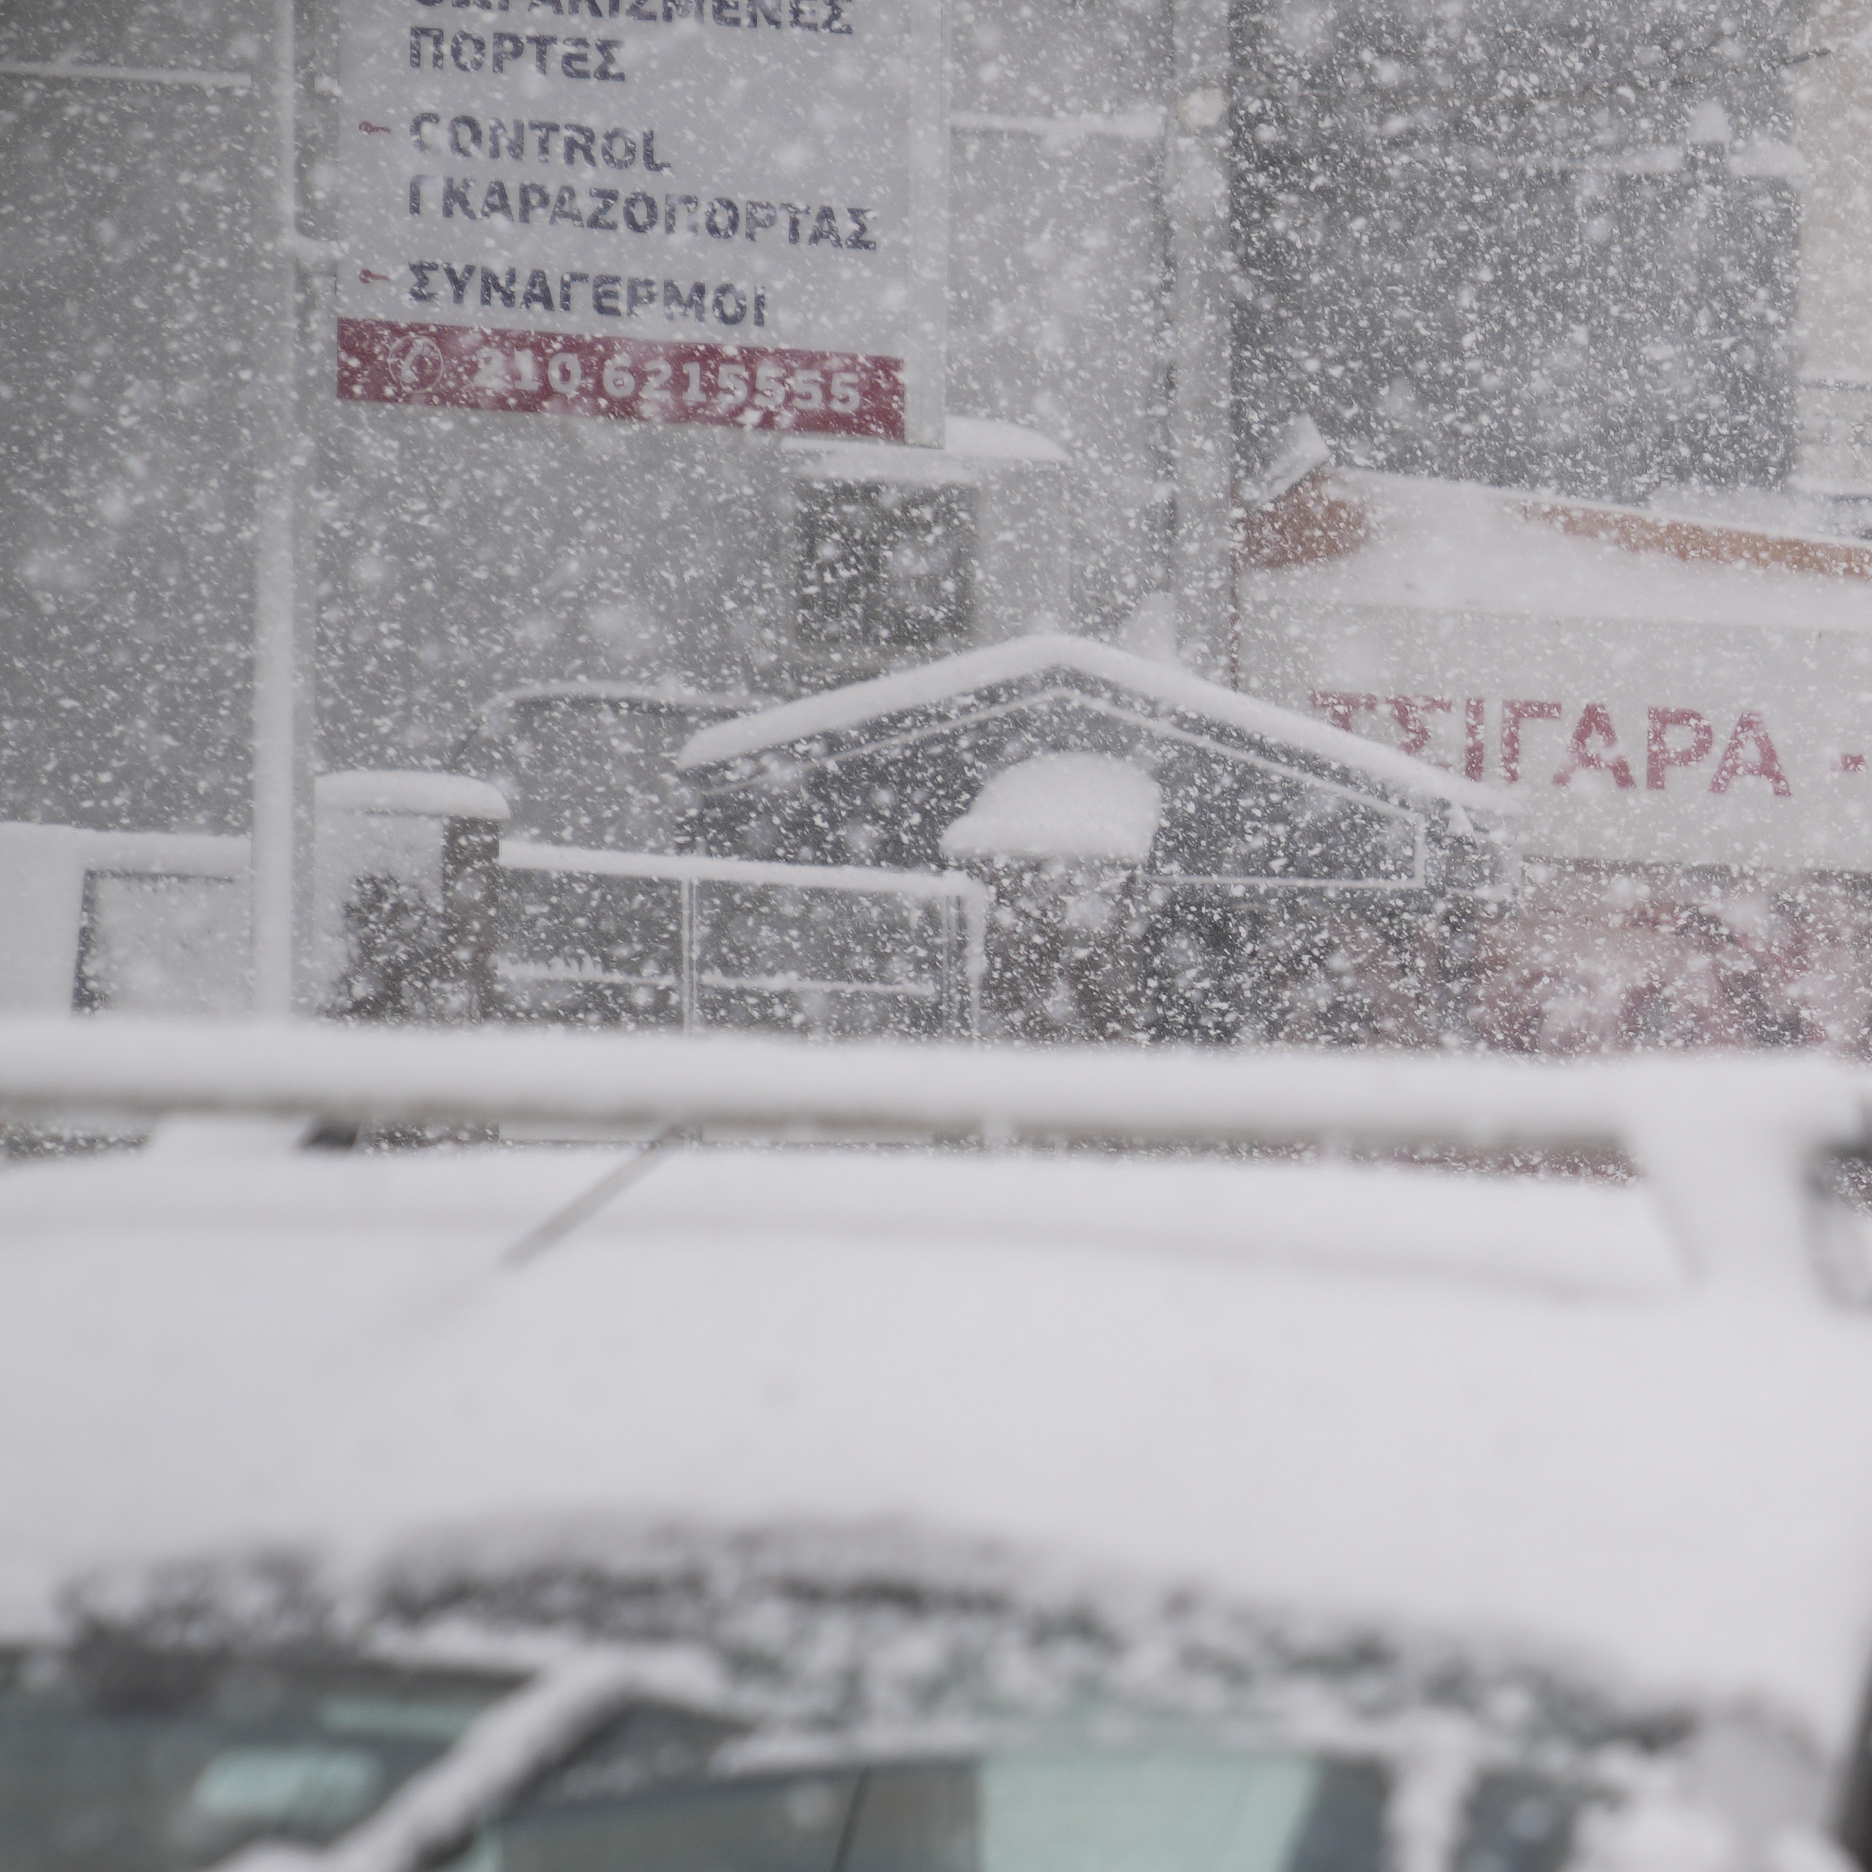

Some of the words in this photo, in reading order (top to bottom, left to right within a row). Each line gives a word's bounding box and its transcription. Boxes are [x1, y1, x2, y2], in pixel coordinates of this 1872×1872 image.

[408, 26, 627, 82] ΠΟΡΤΕΣ
[409, 112, 672, 172] CONTROL
[408, 175, 878, 252] ΓΚΑΡΑΖΟΠΟΡΤΑΣ
[407, 260, 768, 328] ΣΥΝΑΓΕΡΜΟΙ
[472, 347, 583, 395] 210
[601, 353, 861, 413] 6215555
